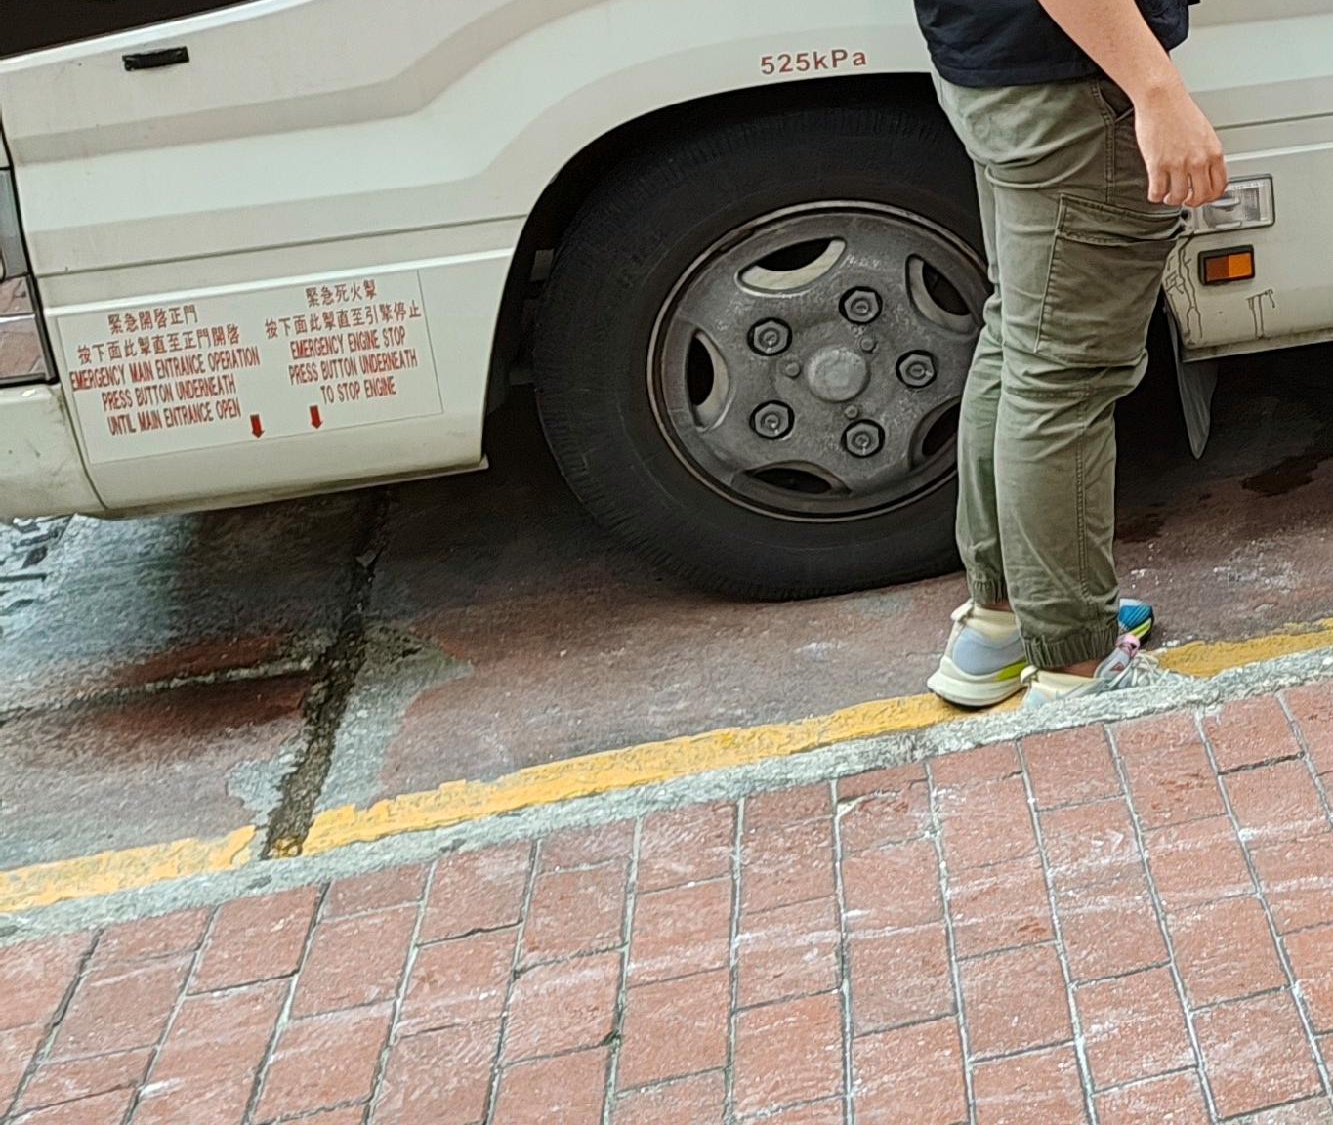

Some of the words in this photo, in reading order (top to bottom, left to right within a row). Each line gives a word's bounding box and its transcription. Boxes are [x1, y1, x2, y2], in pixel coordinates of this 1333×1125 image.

[761, 49, 867, 75] 525kPa
[290, 334, 345, 360] EMERGENCY
[347, 329, 380, 353] ENGINE
[382, 325, 406, 348] STOP
[69, 363, 127, 392] EMERGENCY
[129, 360, 155, 383] MAIN
[155, 353, 207, 380] ENTRANCE
[207, 346, 261, 372] OPERATION
[288, 362, 319, 386] PRESS
[320, 356, 358, 380] BUTTON
[358, 348, 419, 375] UNDERNEATH
[102, 387, 133, 412] PRESS
[135, 382, 174, 407] BUTTON
[175, 373, 237, 400] UNDERNEATH
[319, 384, 335, 405] TO
[336, 380, 361, 403] STOP
[363, 375, 397, 398] ENGINE
[107, 413, 137, 436] UNTIL
[137, 409, 162, 431] MAIN
[163, 402, 214, 428] ENTRANCE
[215, 398, 242, 418] OPEN
